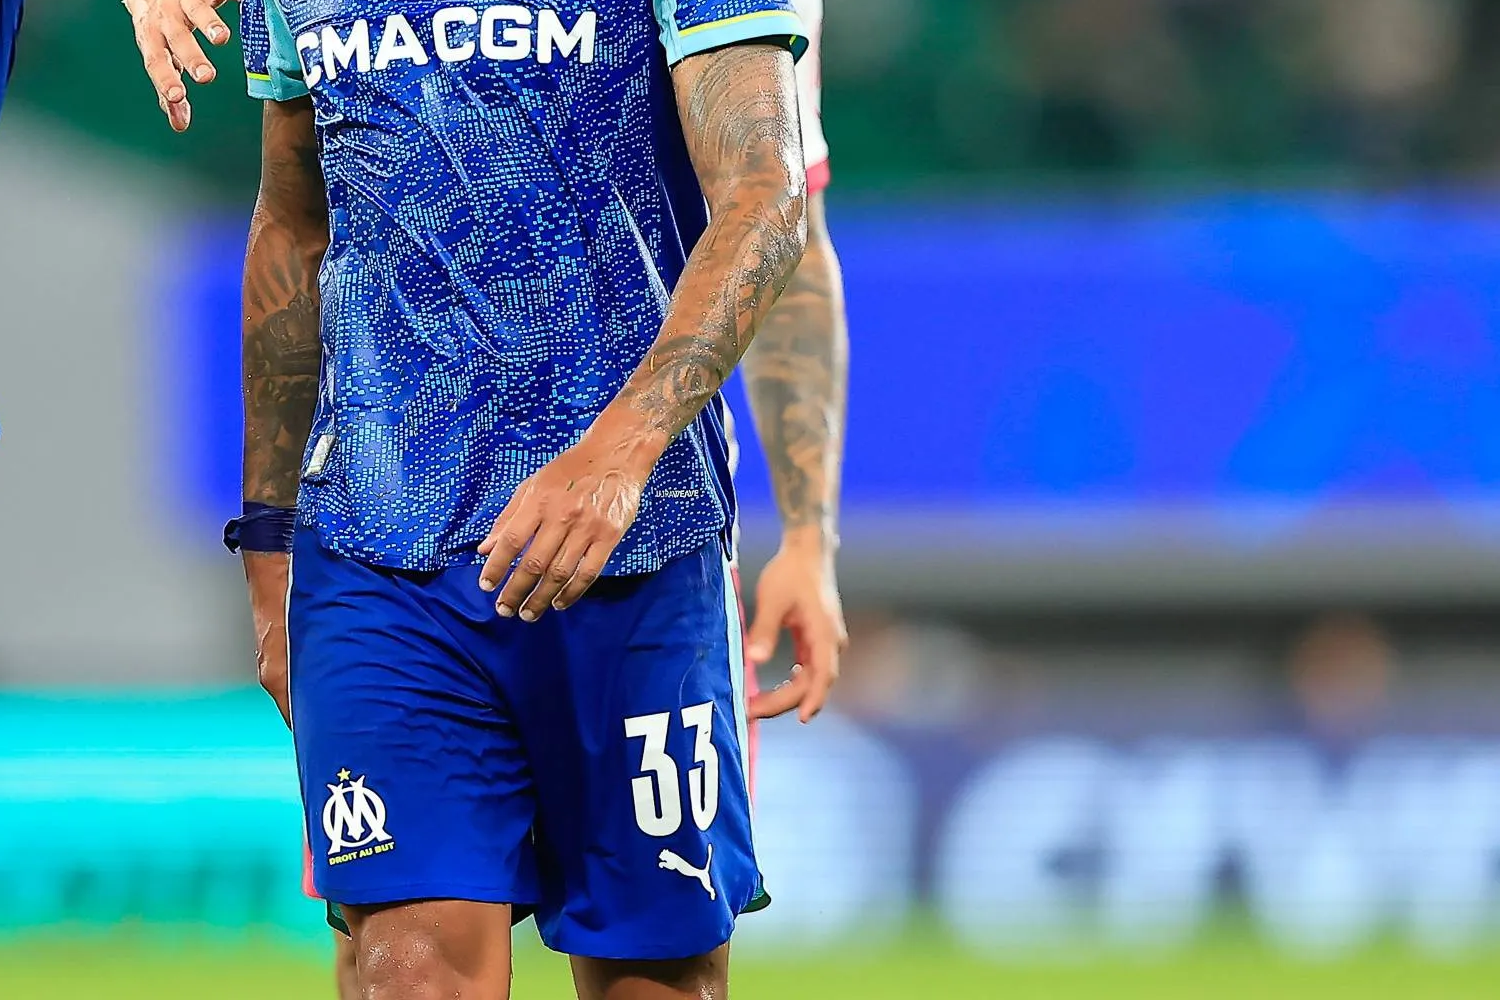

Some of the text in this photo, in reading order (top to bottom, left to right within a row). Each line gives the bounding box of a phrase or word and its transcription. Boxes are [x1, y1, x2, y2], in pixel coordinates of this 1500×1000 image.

[296, 4, 597, 90] CMA CGM
[624, 700, 720, 838] 33
[328, 840, 395, 866] DROIT AU BUT
